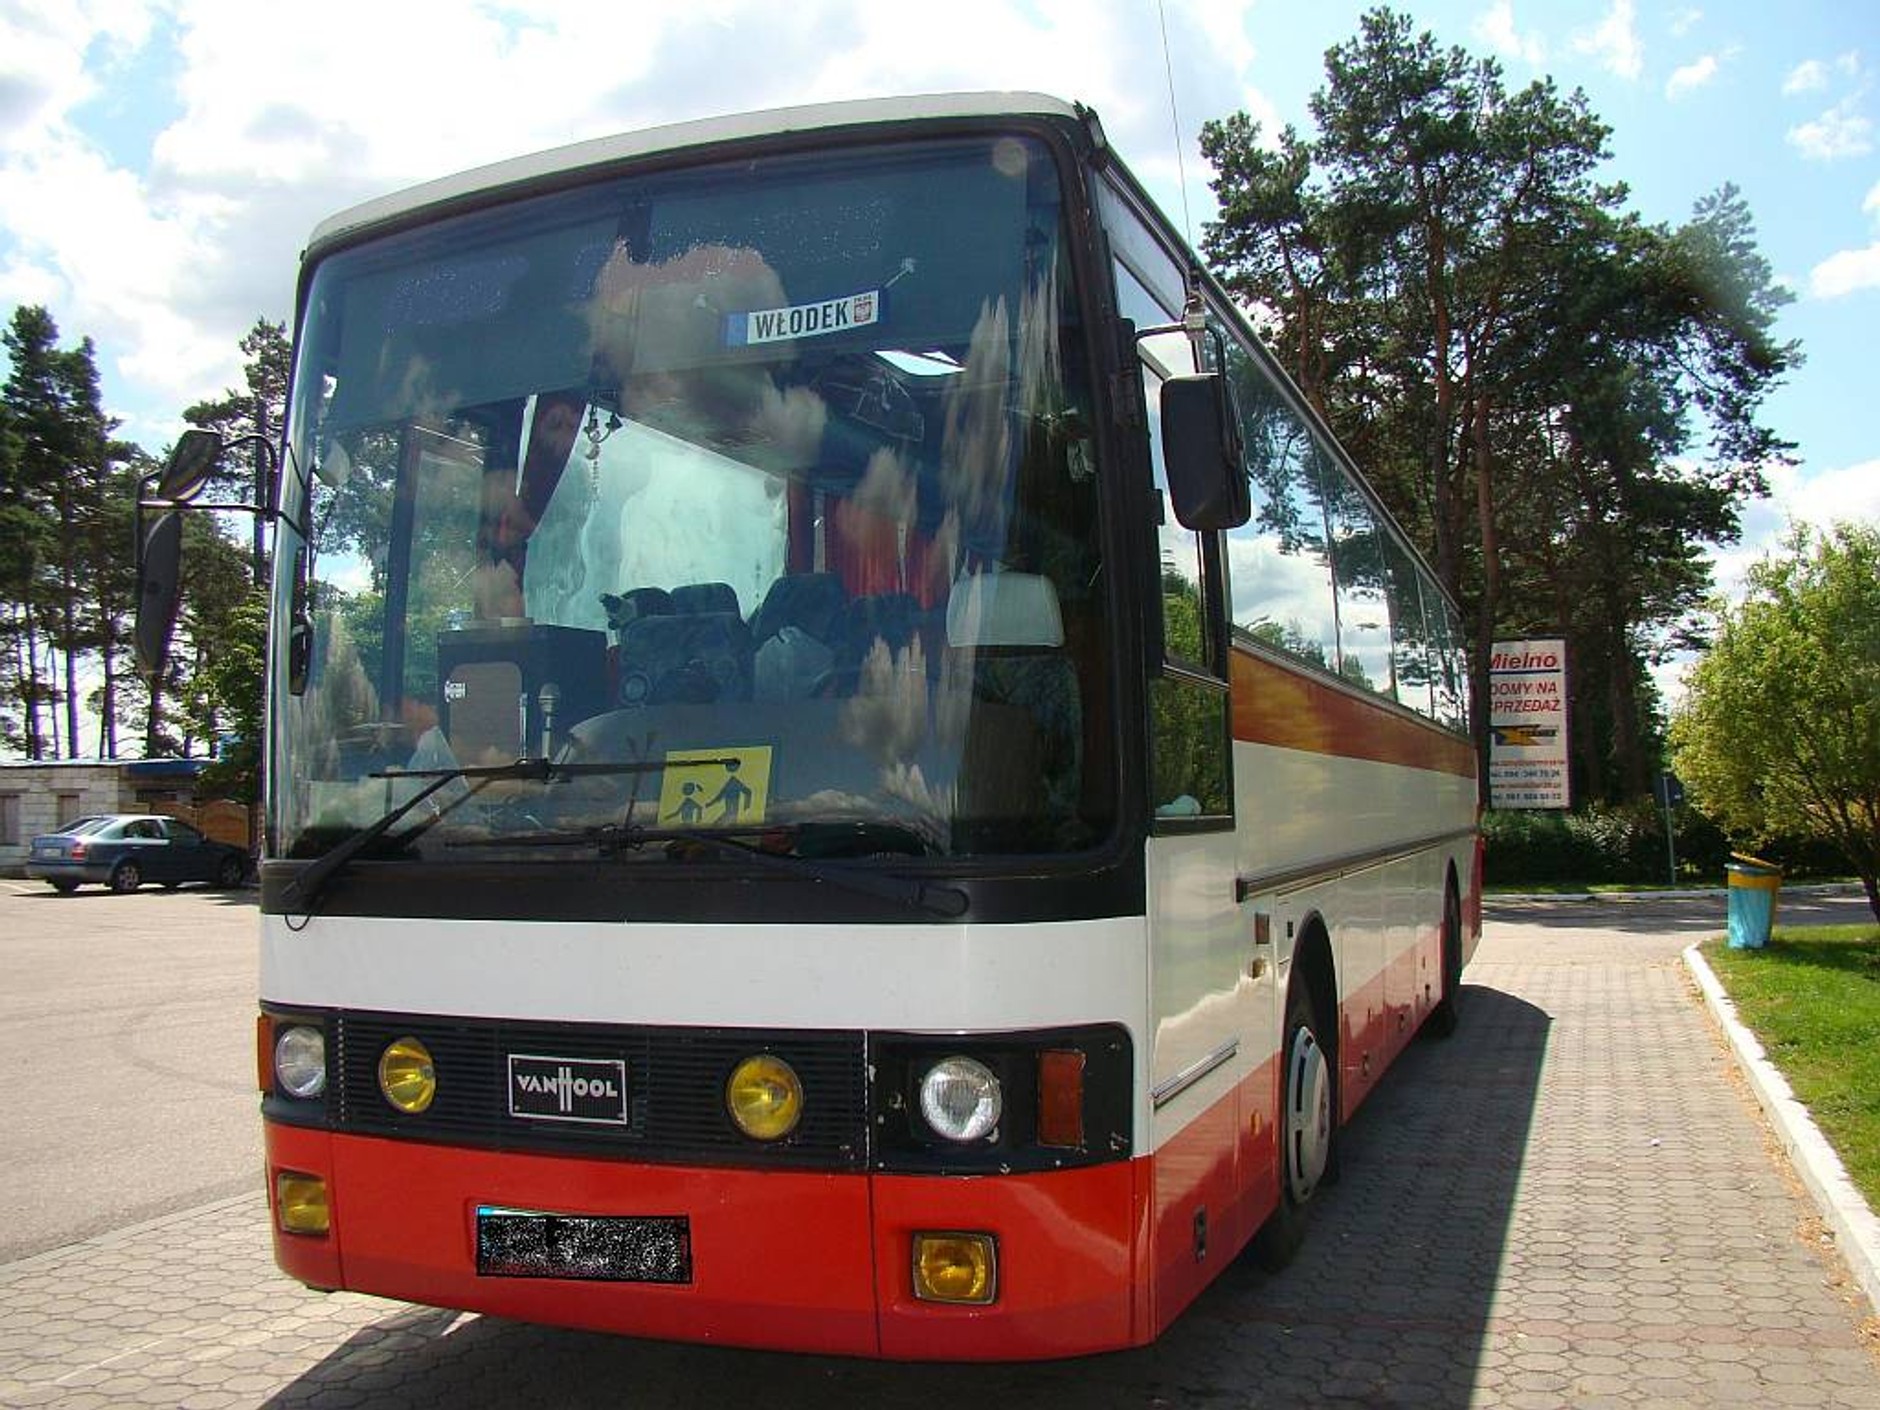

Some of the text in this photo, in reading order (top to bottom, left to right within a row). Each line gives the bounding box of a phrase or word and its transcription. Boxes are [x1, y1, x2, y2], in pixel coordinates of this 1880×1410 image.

[756, 301, 849, 339] WŁODEK
[1491, 652, 1557, 669] Mielno
[1537, 681, 1558, 693] NA
[1491, 697, 1562, 713] PRZEDAŻ
